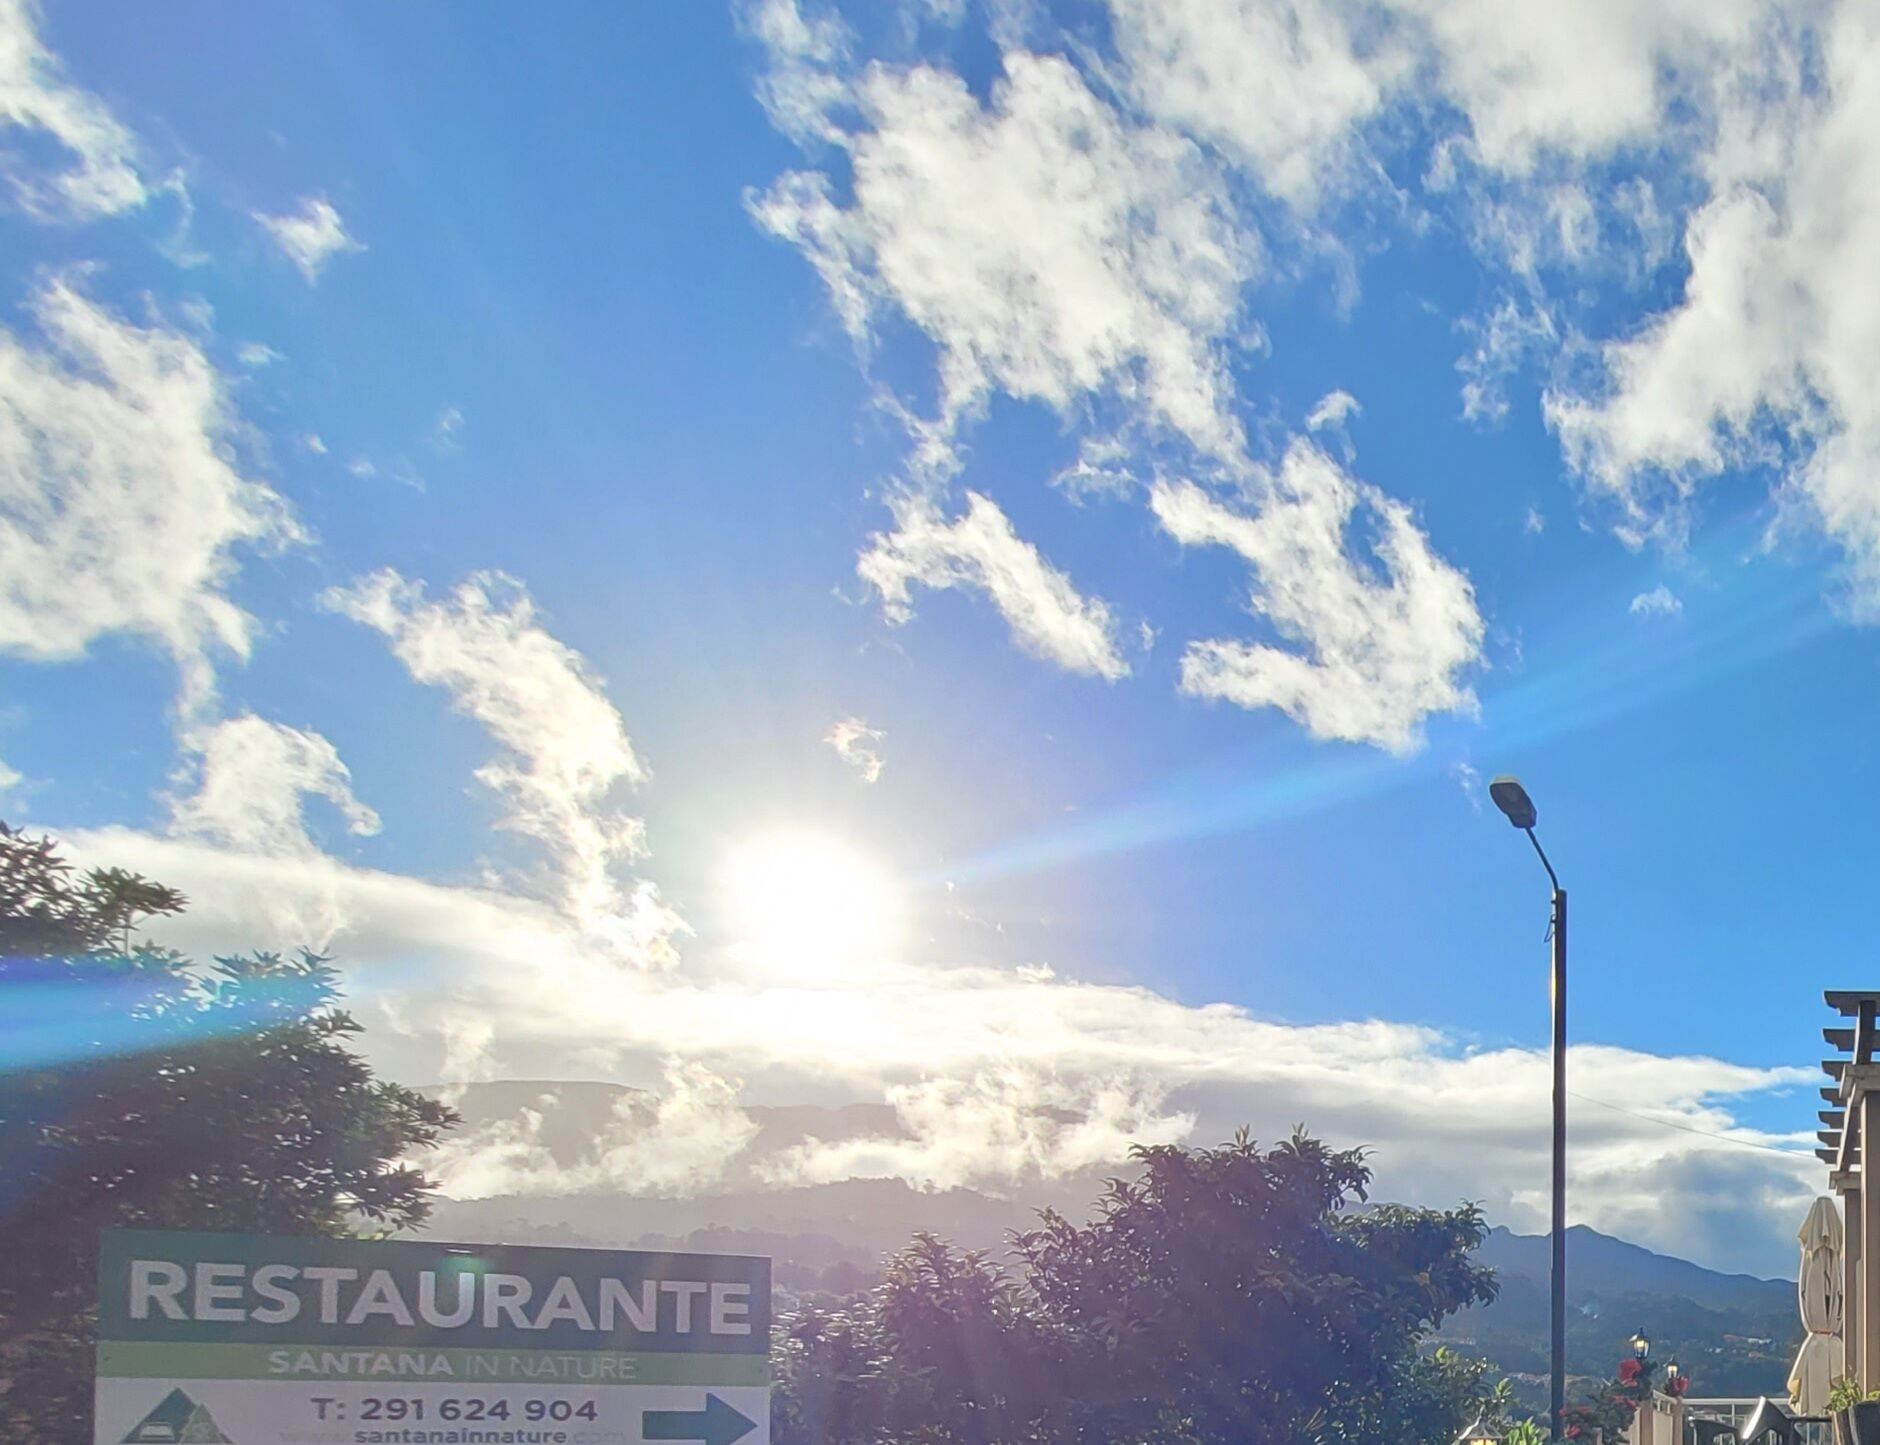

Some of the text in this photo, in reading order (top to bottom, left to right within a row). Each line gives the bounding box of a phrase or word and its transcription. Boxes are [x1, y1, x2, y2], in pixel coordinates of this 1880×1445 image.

[128, 1258, 752, 1336] RESTAURANTE
[267, 1351, 637, 1380] SANTANA IN NATURE
[310, 1397, 599, 1422] T: 291 624 904
